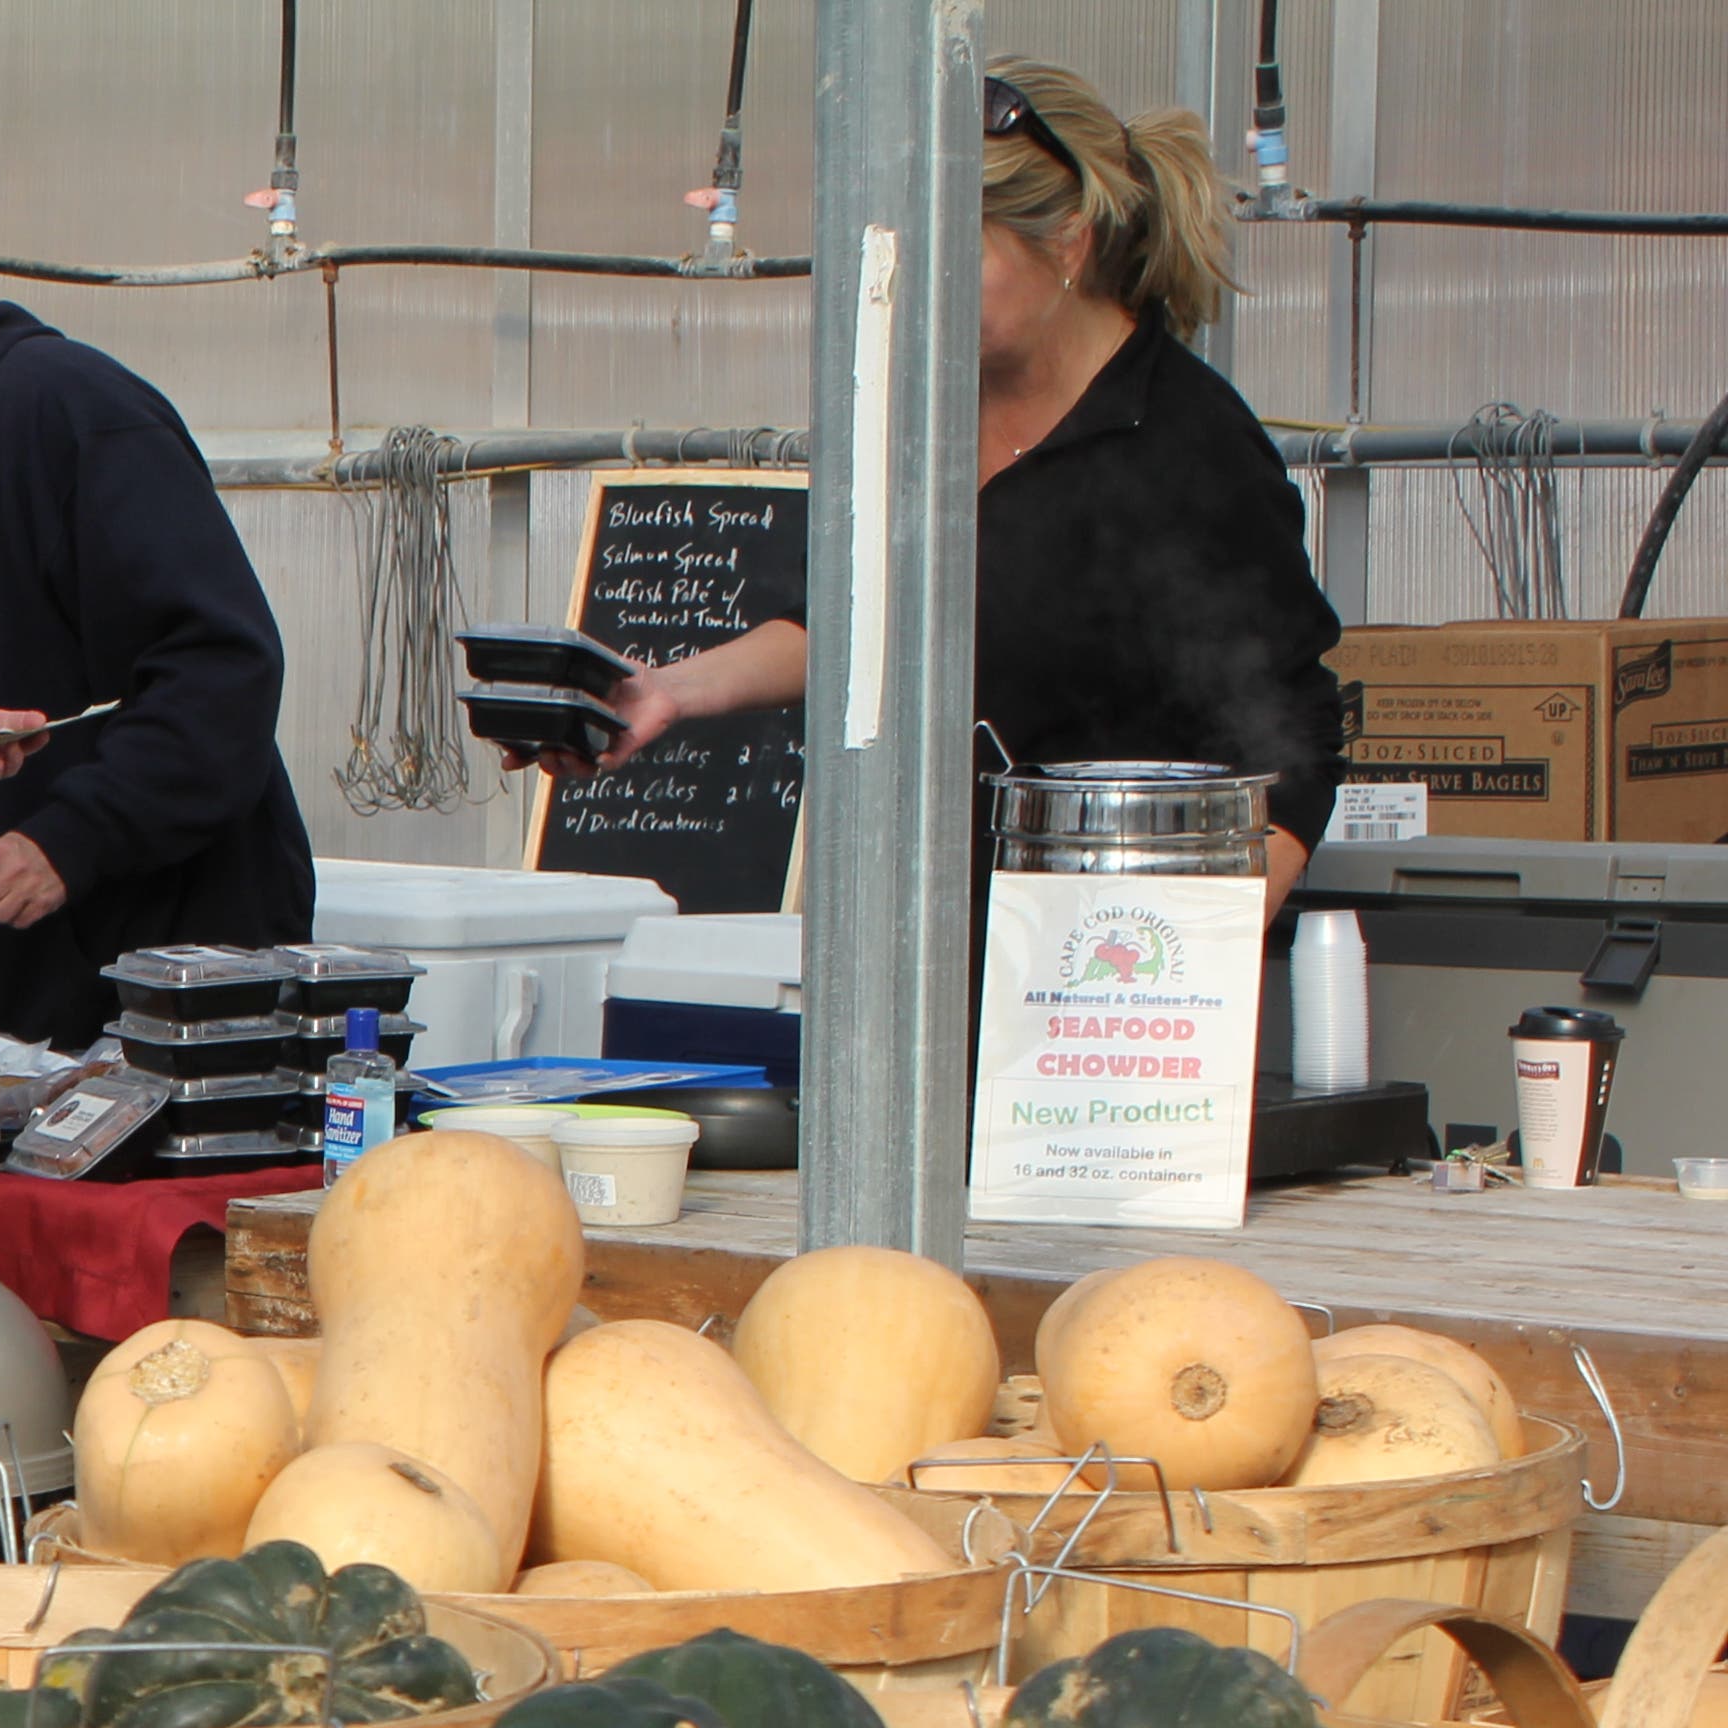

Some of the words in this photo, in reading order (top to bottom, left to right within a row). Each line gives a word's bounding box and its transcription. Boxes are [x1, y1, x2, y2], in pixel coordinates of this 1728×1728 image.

[609, 500, 693, 528] Bluefish
[708, 501, 774, 533] Spread
[603, 543, 668, 569] Salmon
[674, 543, 738, 574] Spread
[594, 579, 662, 604] Codfish
[618, 610, 688, 629] Sundried
[694, 608, 748, 630] Tomato
[1548, 702, 1566, 717] UP
[562, 774, 634, 803] Codfish
[1472, 772, 1542, 791] BAGELS
[1058, 929, 1084, 978] CAPE
[1083, 906, 1124, 930] COD
[1024, 991, 1047, 1004] All
[1050, 991, 1110, 1005] Natural
[1046, 1015, 1196, 1041] SEAFOOD
[1036, 1053, 1202, 1079] CHOWDER
[328, 1107, 355, 1127] Hand
[1011, 1101, 1078, 1126] New
[1088, 1098, 1215, 1124] Product
[325, 1124, 362, 1145] Sanitizer
[1045, 1143, 1081, 1158] Now
[1084, 1145, 1155, 1161] available
[1158, 1146, 1172, 1160] in
[1013, 1163, 1032, 1177] 16
[1035, 1165, 1065, 1178] and
[1068, 1165, 1088, 1179] 32
[1119, 1168, 1203, 1183] containers
